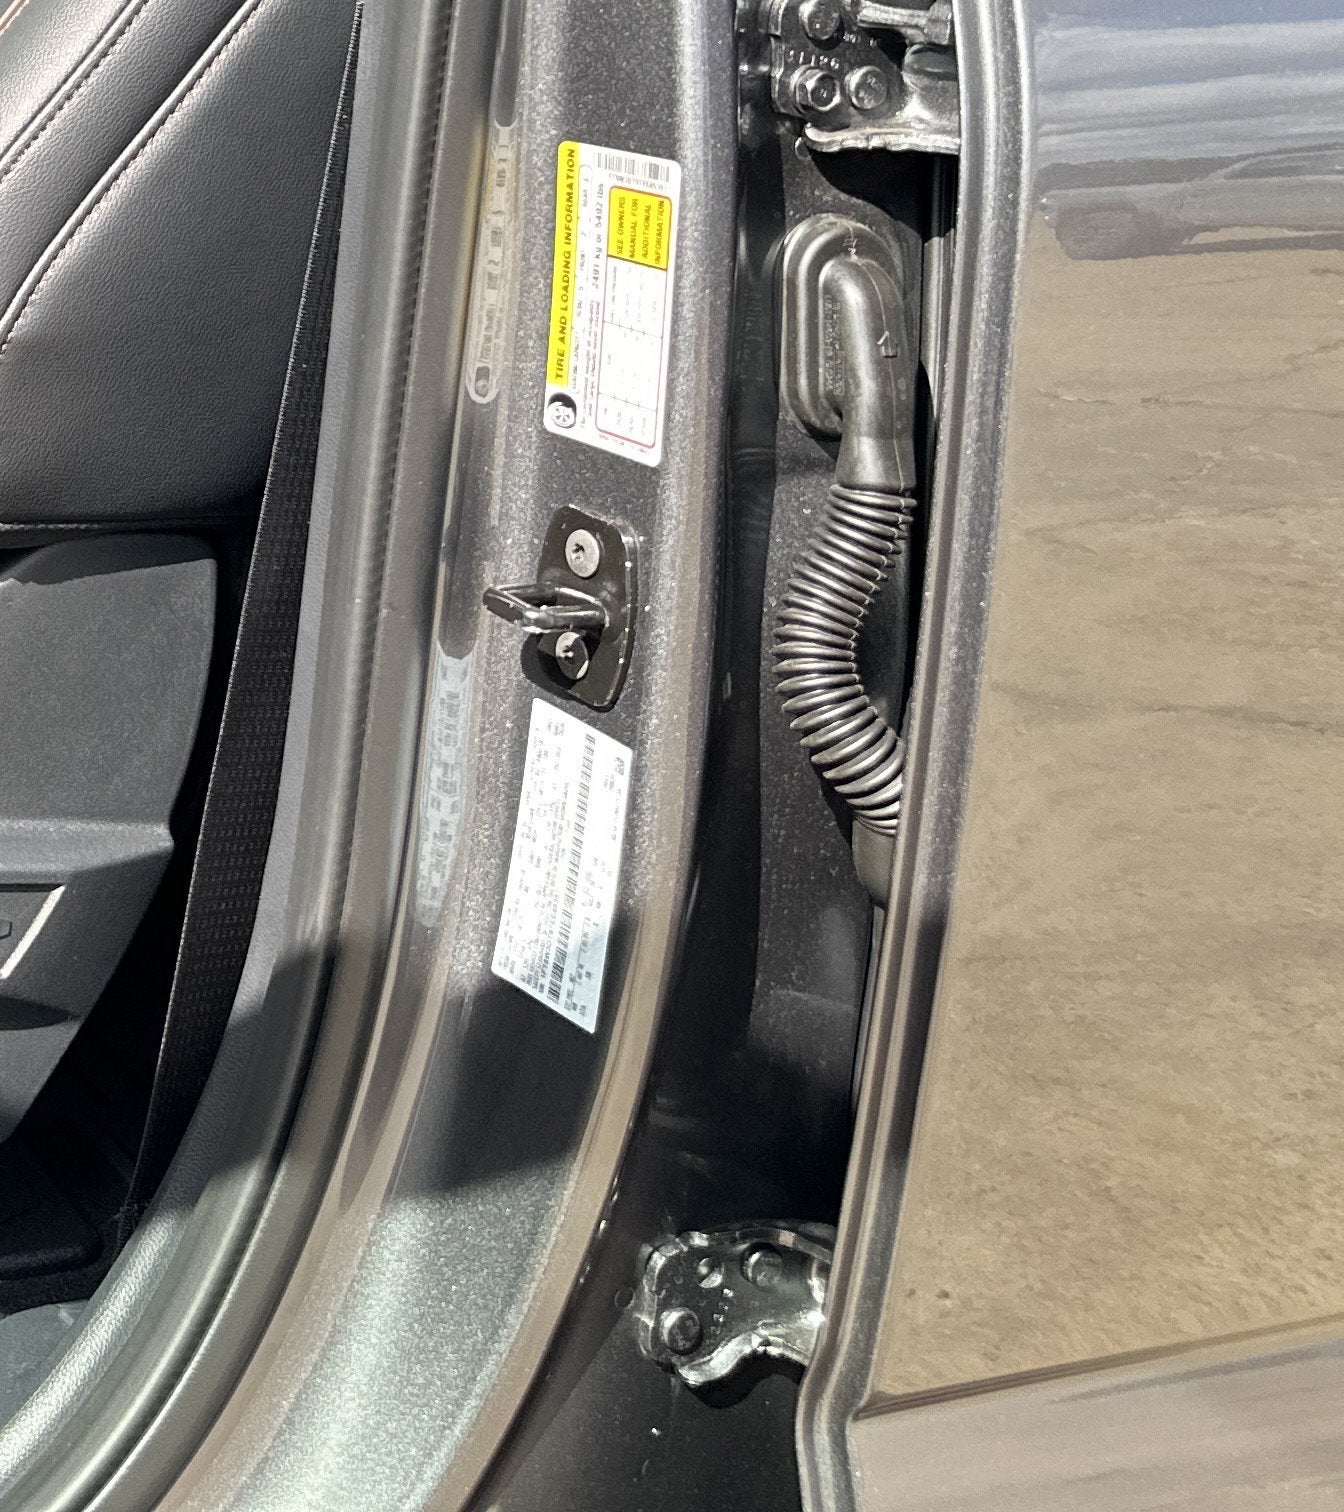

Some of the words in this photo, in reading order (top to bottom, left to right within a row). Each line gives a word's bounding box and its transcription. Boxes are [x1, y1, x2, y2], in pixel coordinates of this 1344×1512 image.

[563, 148, 575, 246] INFORMATION
[631, 198, 639, 217] FOR
[616, 239, 624, 255] SEE
[629, 220, 638, 259] MANUAL
[642, 203, 652, 259] ADDITIONAL
[654, 200, 665, 265] INFORMATION
[595, 247, 602, 259] kg
[560, 250, 571, 312] LOADING
[558, 315, 568, 345] AND
[555, 348, 565, 380] TIRE
